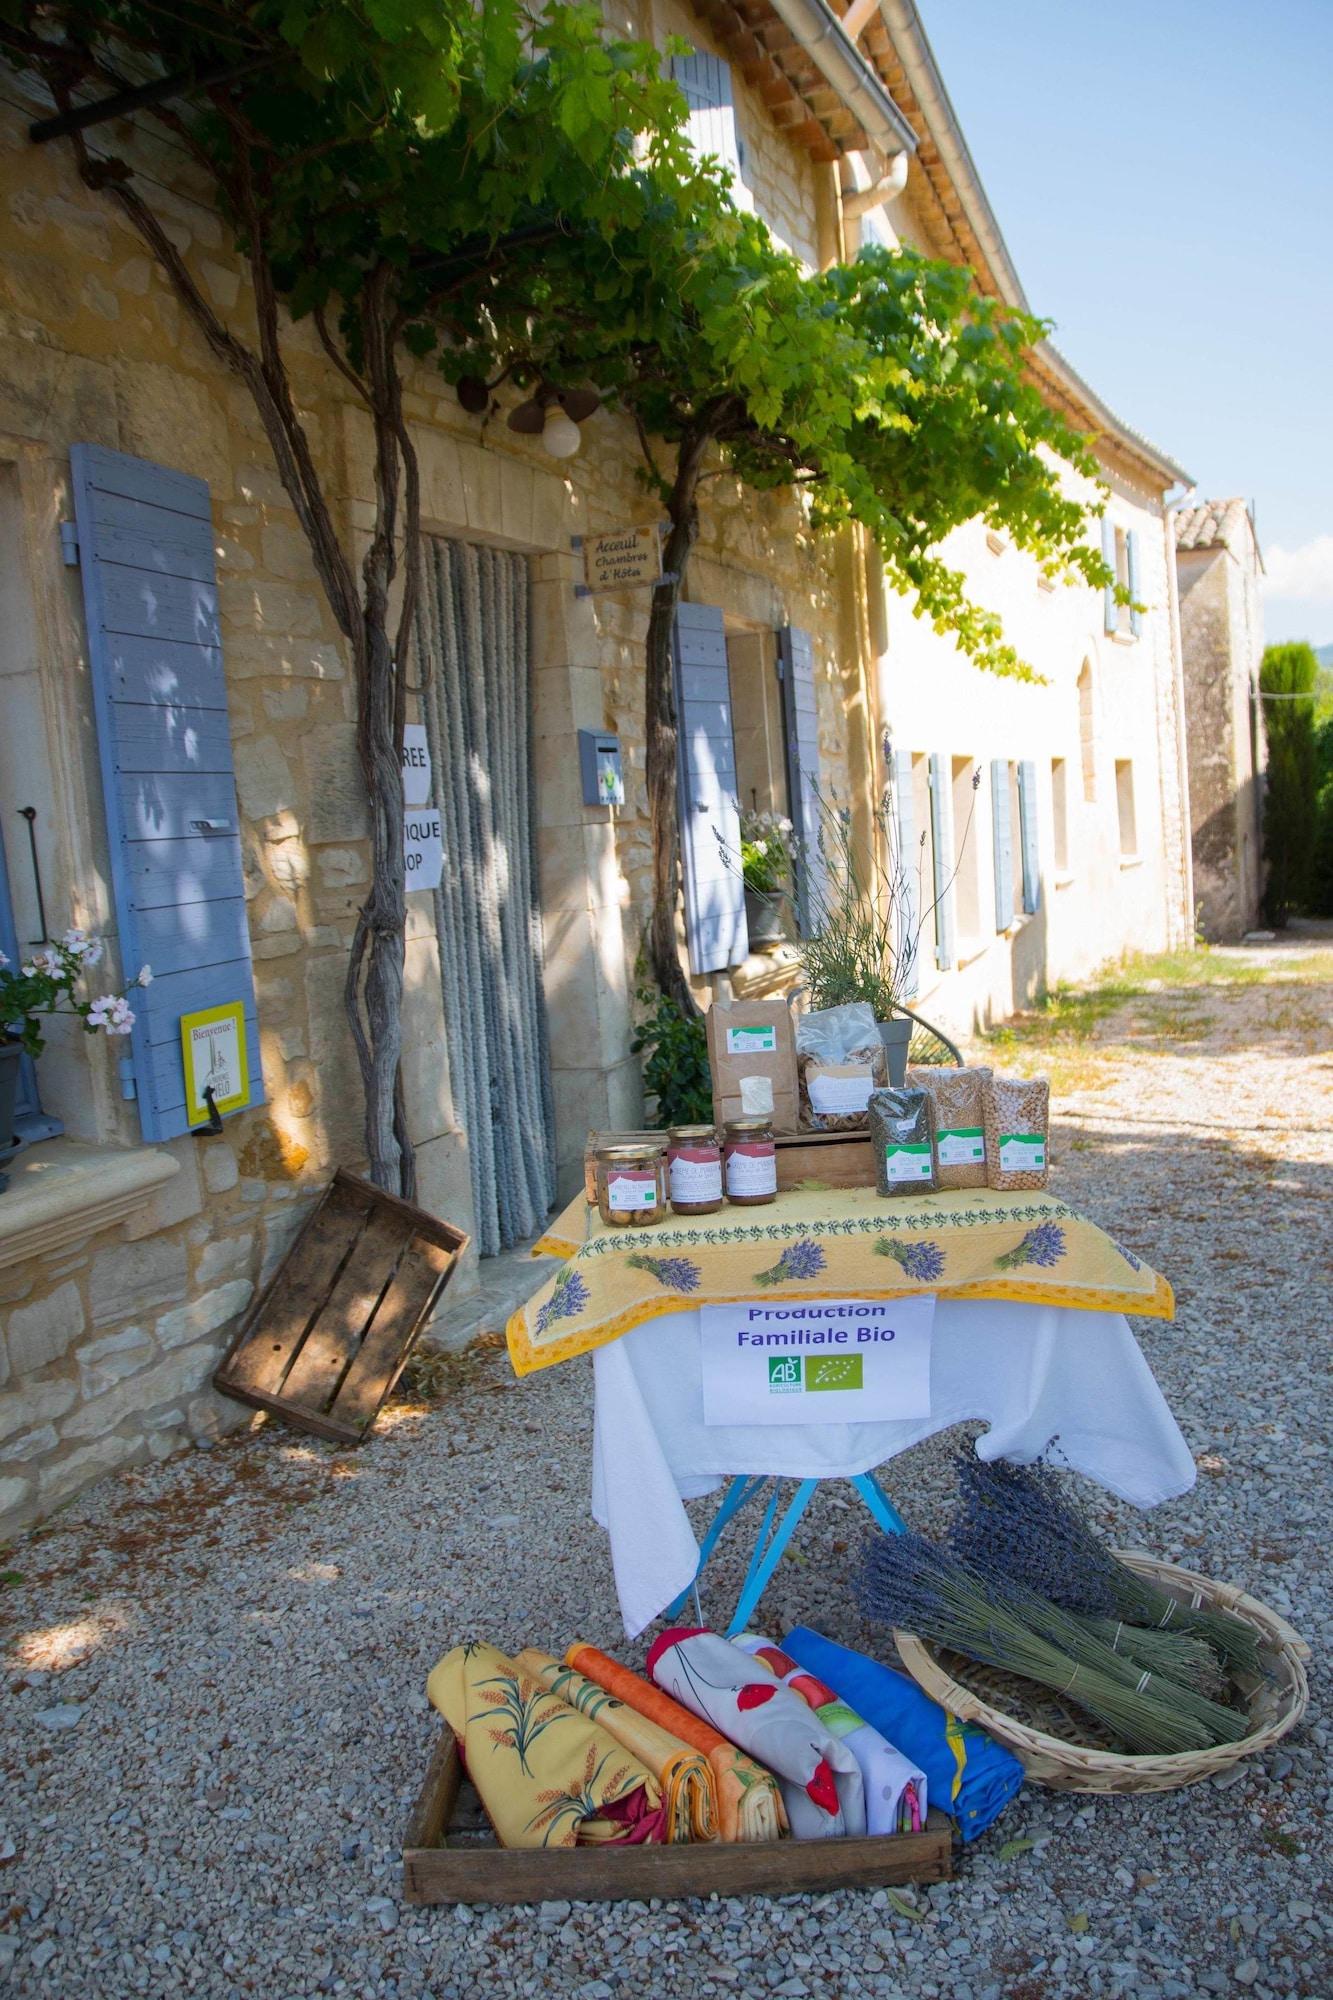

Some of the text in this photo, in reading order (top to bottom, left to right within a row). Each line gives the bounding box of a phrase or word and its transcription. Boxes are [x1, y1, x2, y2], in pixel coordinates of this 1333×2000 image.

[596, 552, 648, 567] Chambres
[402, 747, 426, 767] REE
[404, 822, 440, 842] IQUE
[748, 1305, 886, 1321] Production
[738, 1327, 895, 1346] Familiale Bio
[771, 1363, 797, 1382] AB
